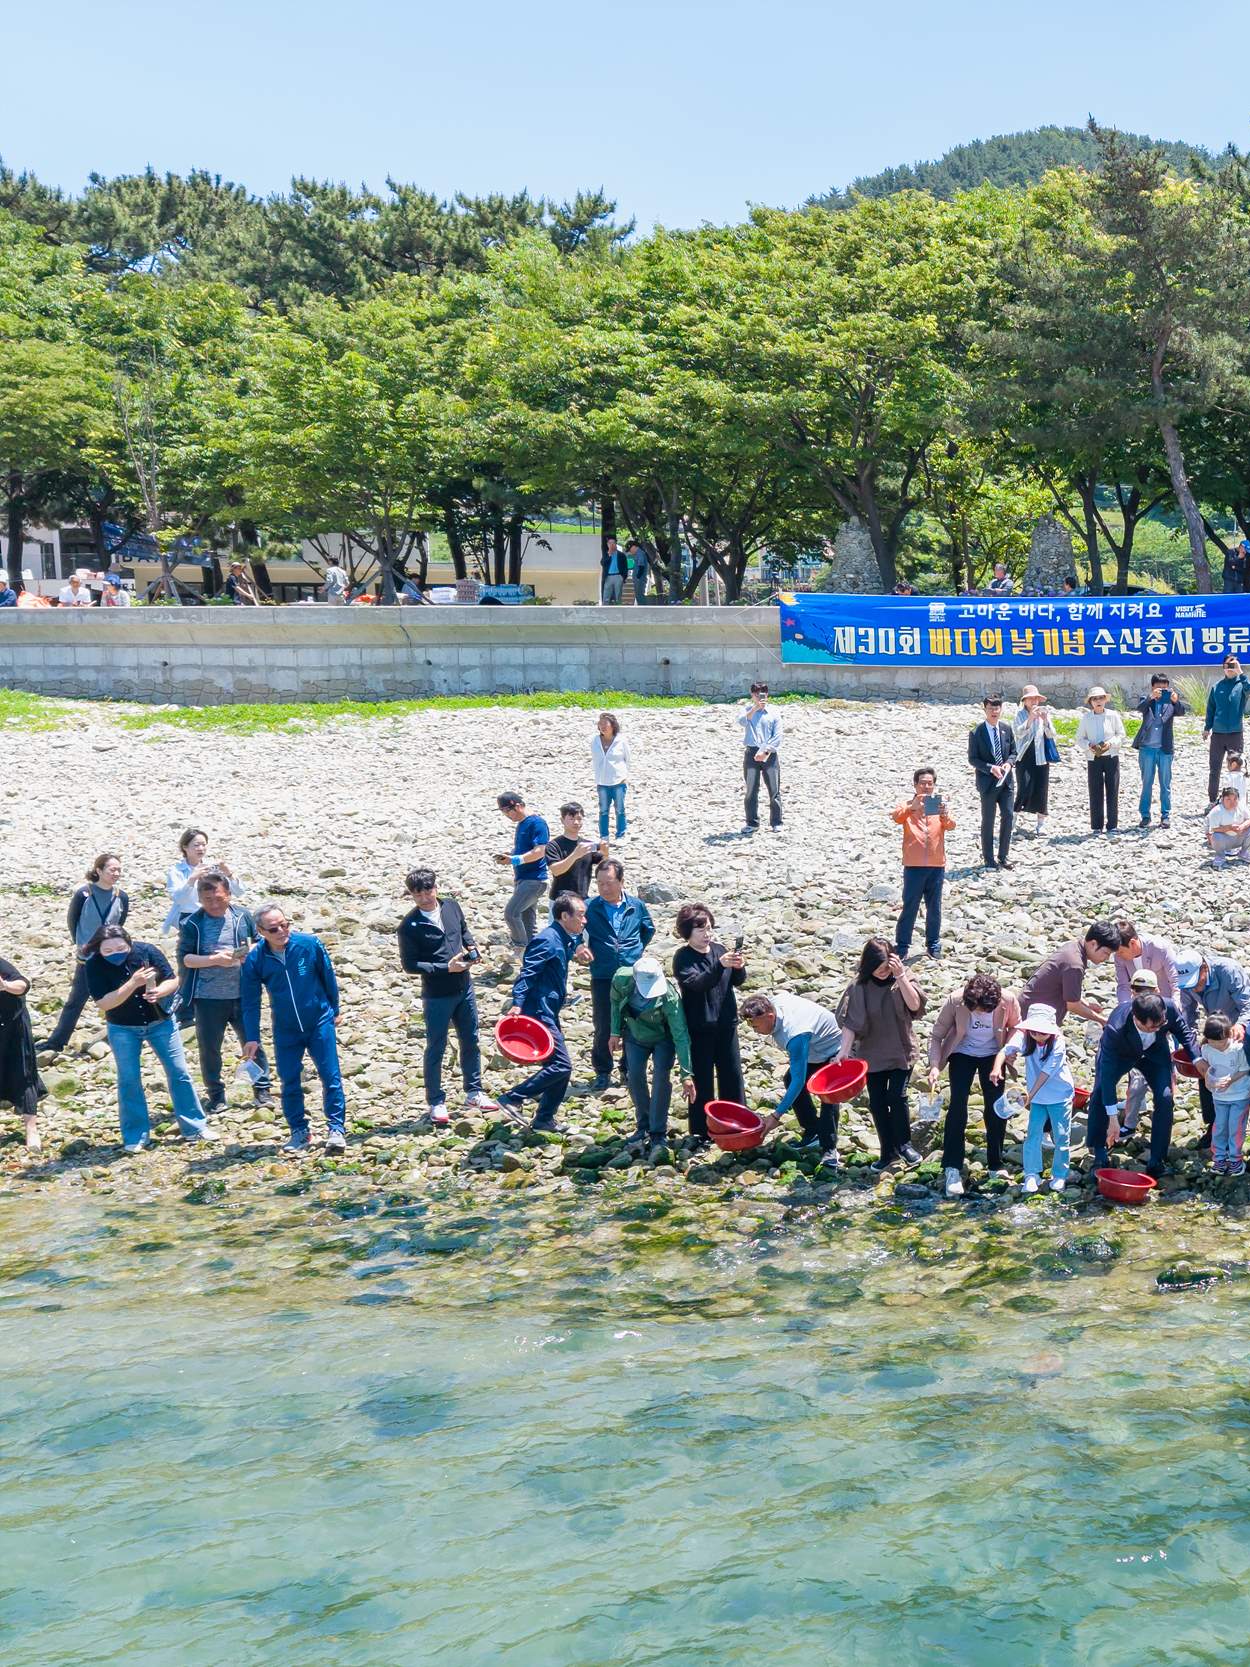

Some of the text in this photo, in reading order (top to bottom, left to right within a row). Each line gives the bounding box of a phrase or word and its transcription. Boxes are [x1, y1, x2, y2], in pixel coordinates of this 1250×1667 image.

[958, 602, 1163, 622] 고마운 바다, 함께 지켜요
[833, 626, 921, 655] 제30회
[929, 627, 1003, 656] 바다의
[1093, 627, 1195, 655] 수산종자
